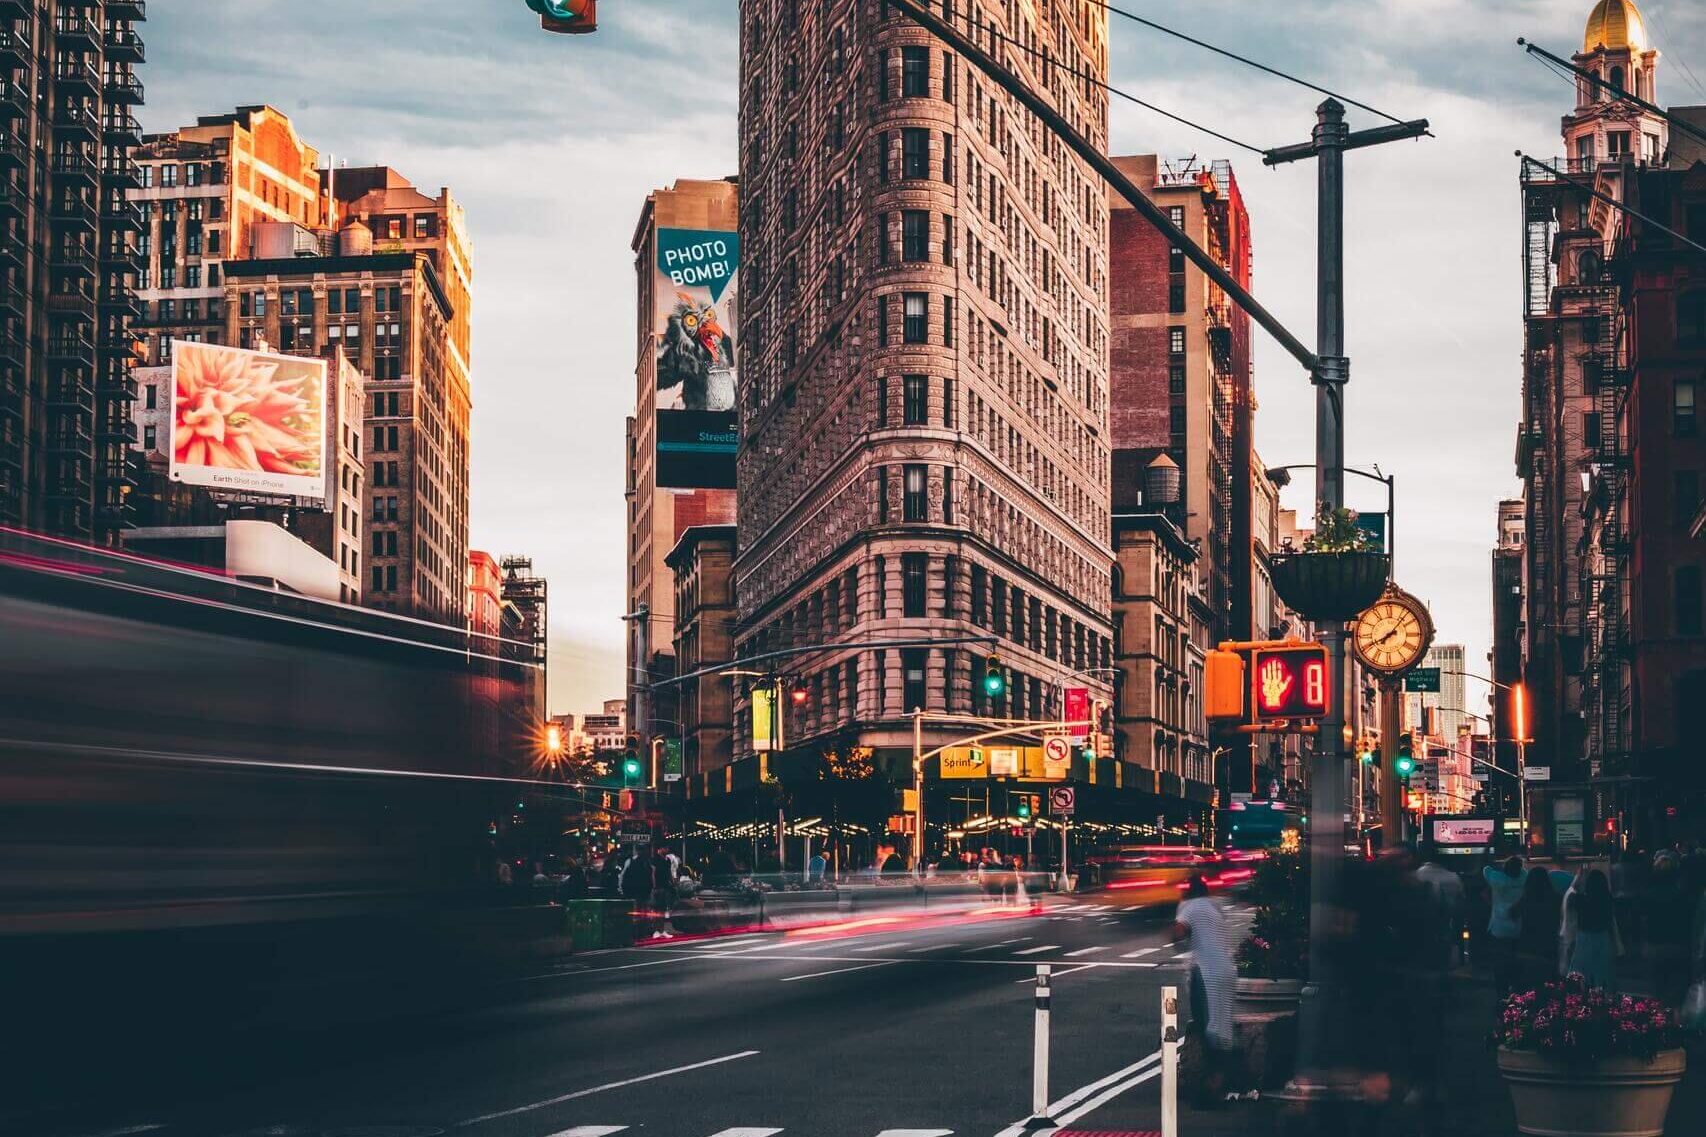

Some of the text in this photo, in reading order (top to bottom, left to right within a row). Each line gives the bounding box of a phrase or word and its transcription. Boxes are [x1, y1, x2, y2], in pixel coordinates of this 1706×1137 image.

[665, 240, 727, 267] PHOTO
[670, 260, 731, 287] BOMB!
[213, 474, 233, 483] Earth
[233, 477, 250, 485] Shot
[261, 478, 284, 488] iPhone
[944, 758, 971, 769] Sprint
